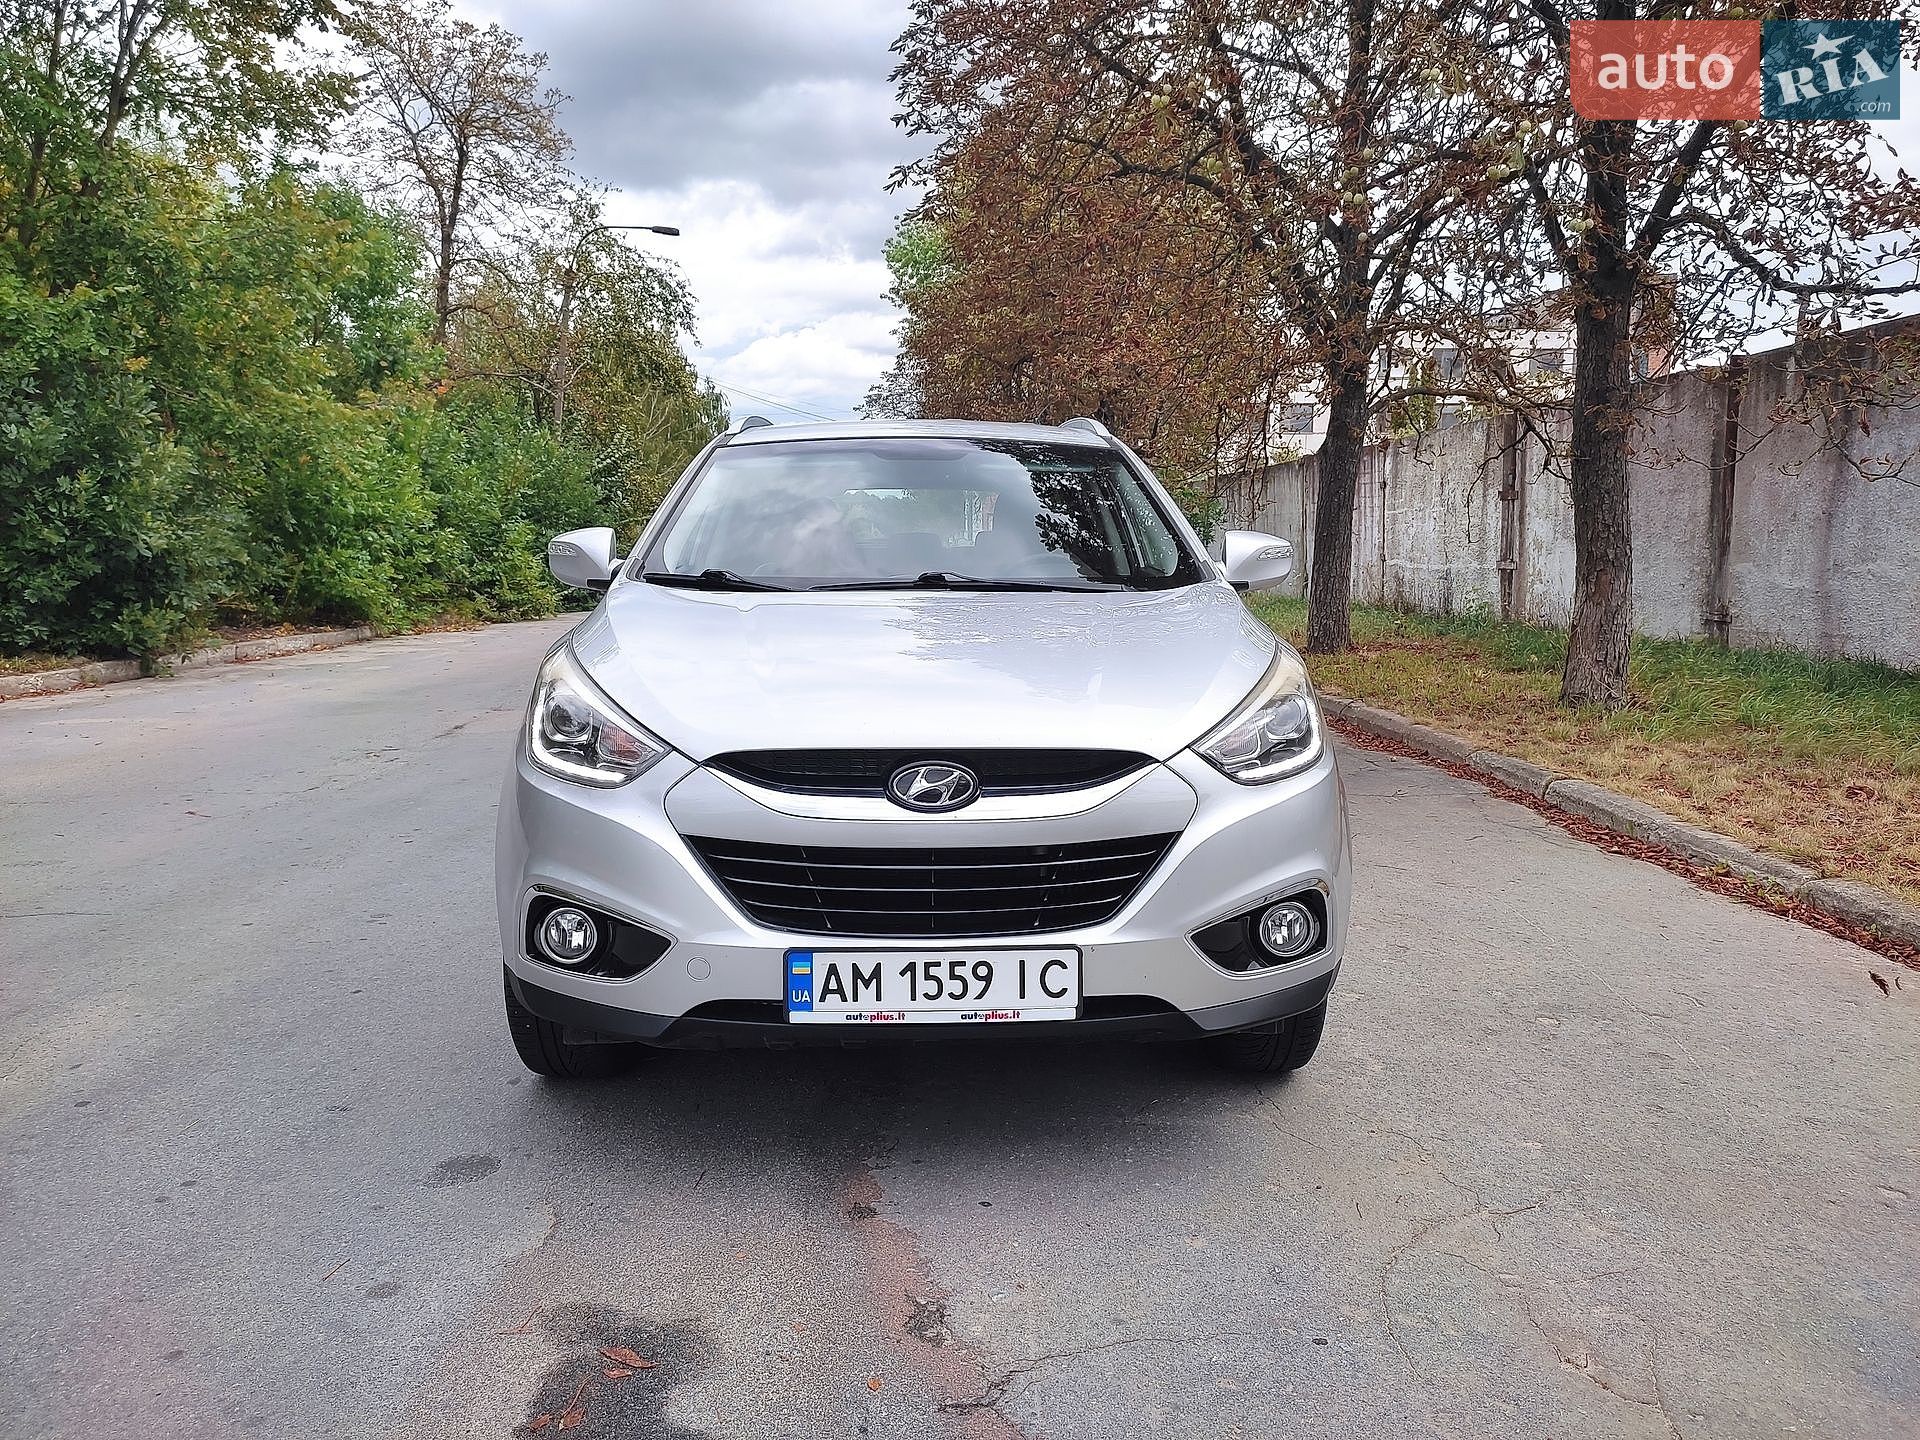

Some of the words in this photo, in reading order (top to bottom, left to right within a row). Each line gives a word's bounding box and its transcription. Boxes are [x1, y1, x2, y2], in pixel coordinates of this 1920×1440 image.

[819, 962, 882, 1003] AM
[898, 960, 994, 1001] 1559
[1018, 959, 1069, 999] IC
[792, 990, 811, 1003] UA
[845, 1011, 906, 1023] autoplius.lt
[960, 1010, 1021, 1021] autoplius.lt
